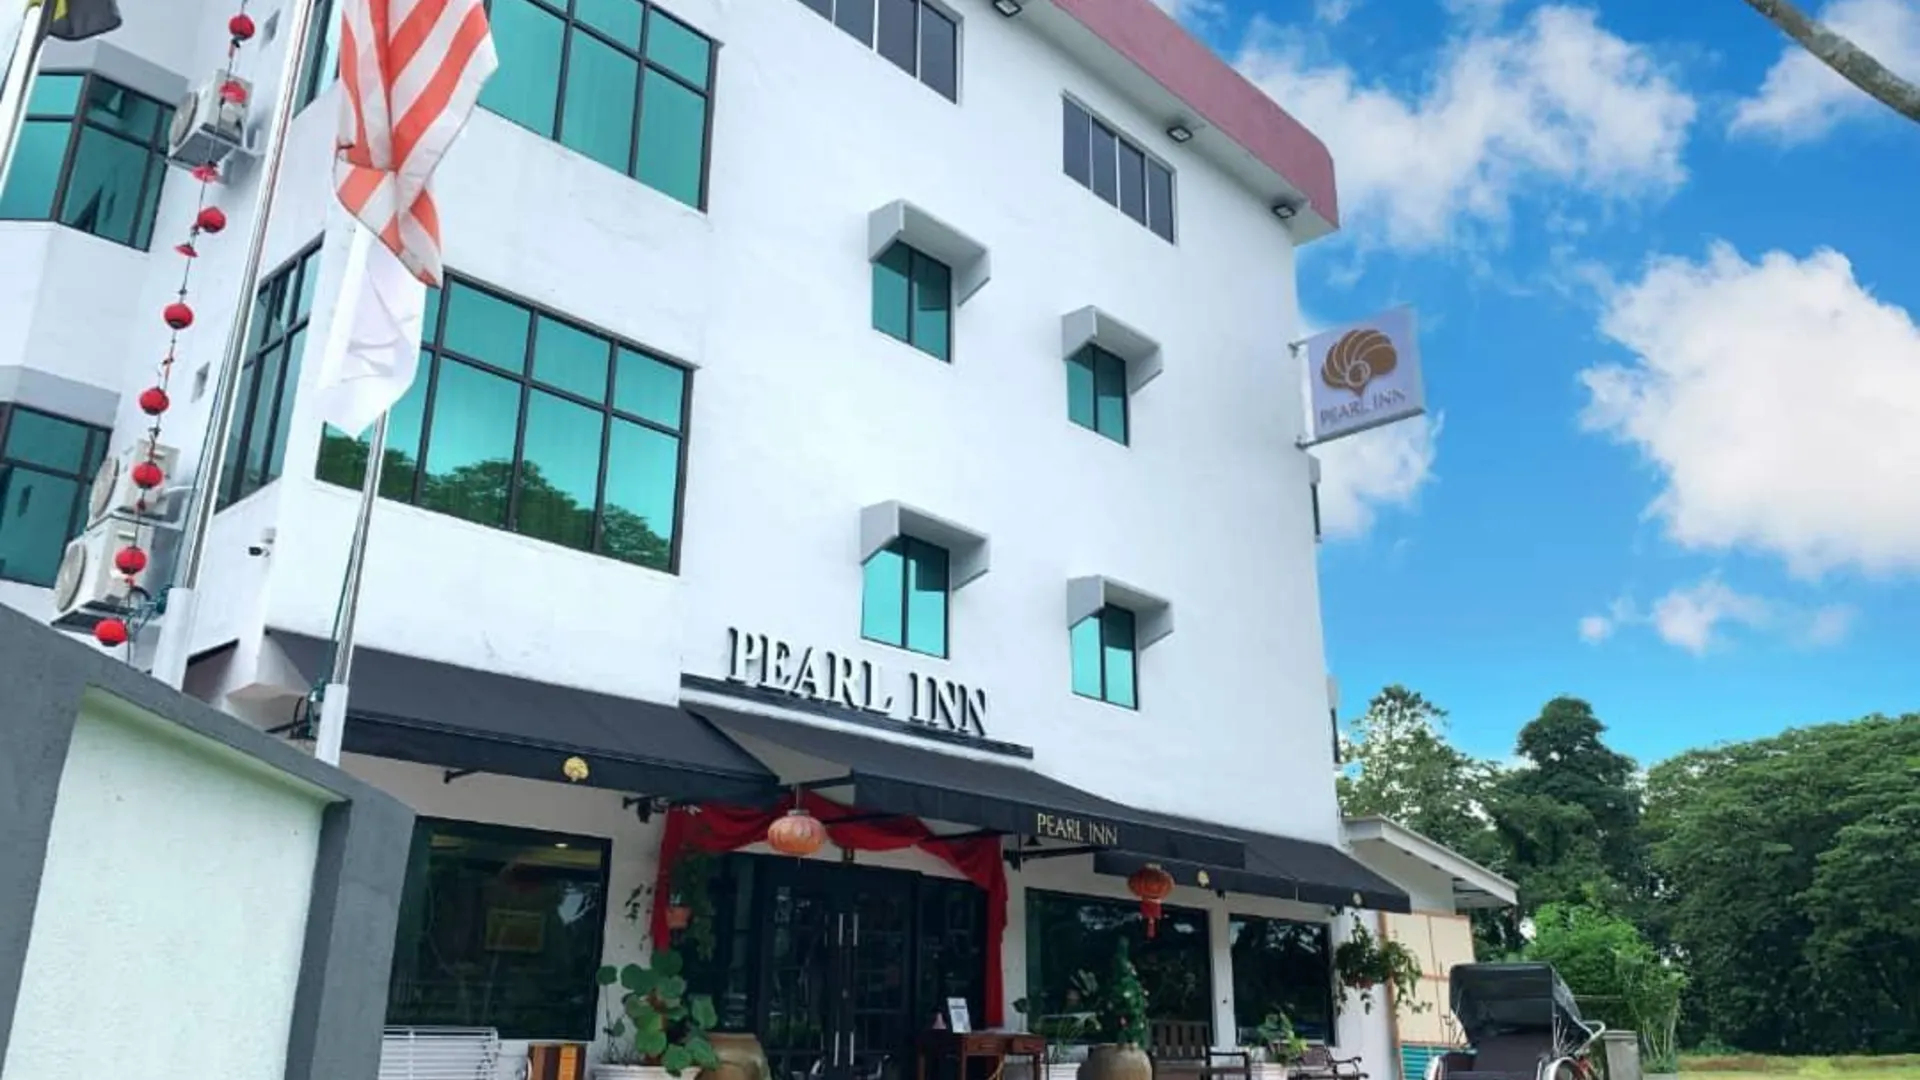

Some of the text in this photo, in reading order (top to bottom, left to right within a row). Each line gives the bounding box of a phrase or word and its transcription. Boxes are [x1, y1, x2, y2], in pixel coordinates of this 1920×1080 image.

[726, 626, 987, 737] PEARL INN
[1037, 812, 1118, 845] PEARL INN
